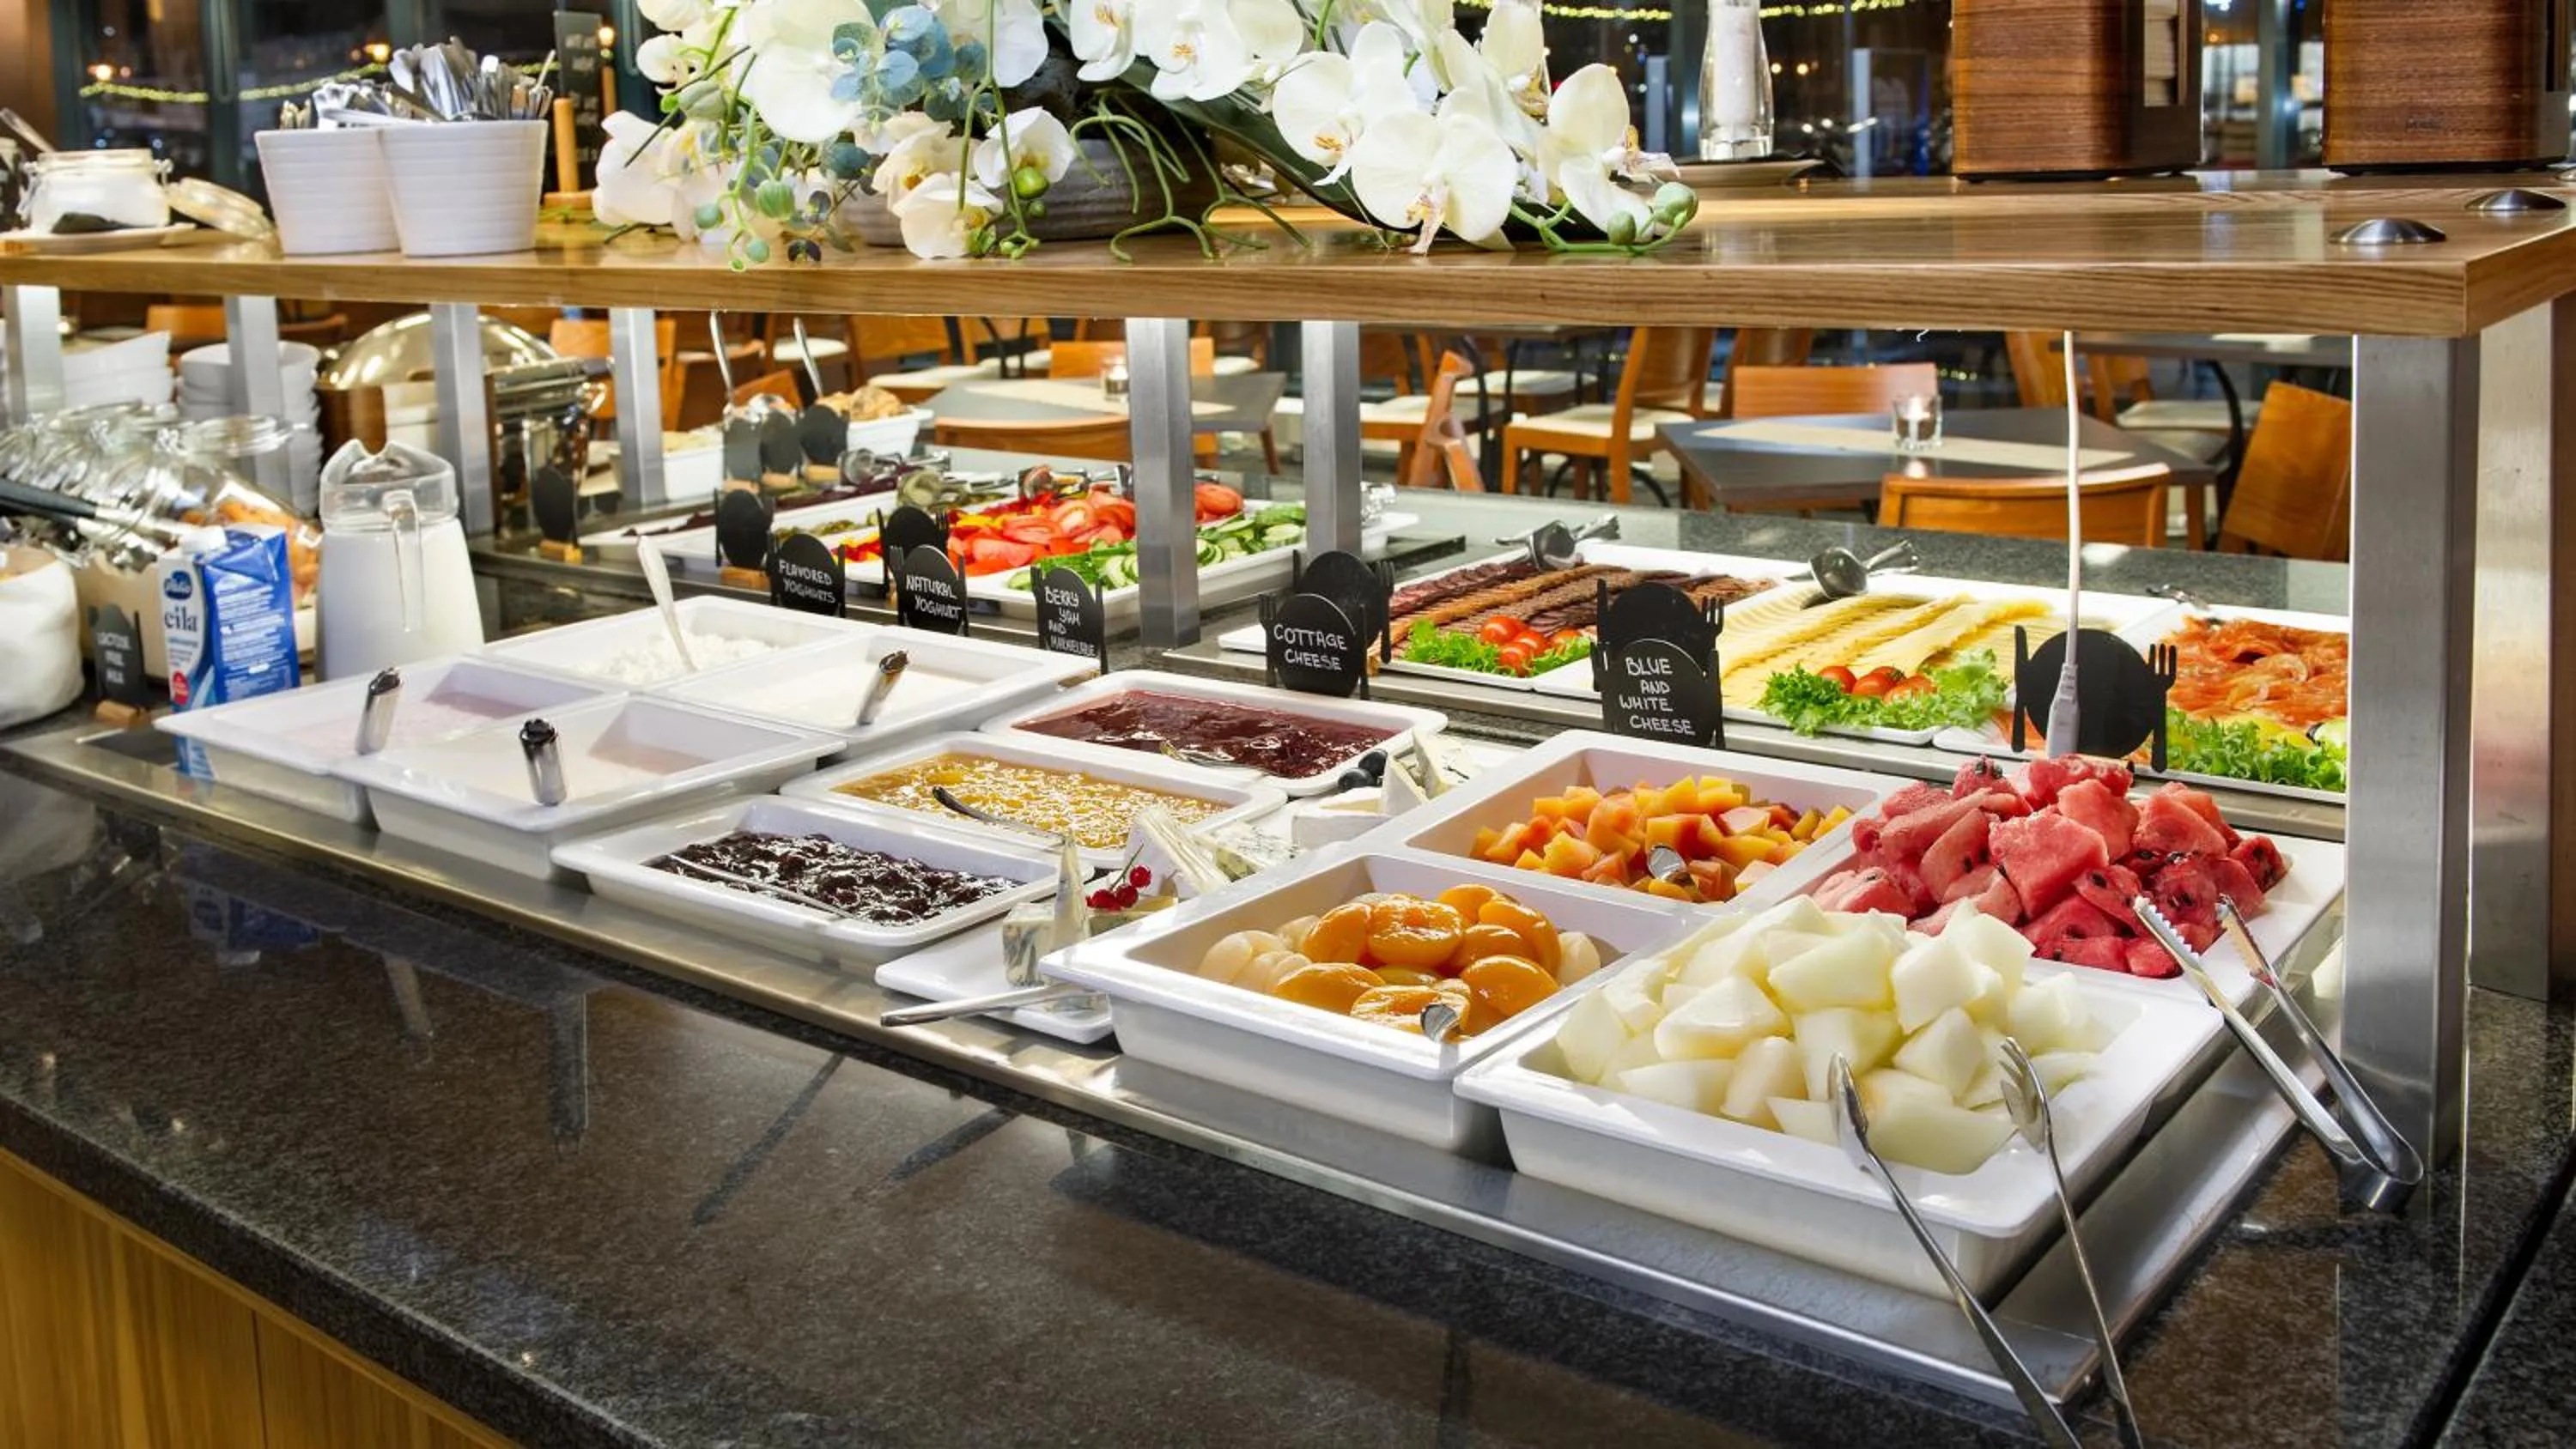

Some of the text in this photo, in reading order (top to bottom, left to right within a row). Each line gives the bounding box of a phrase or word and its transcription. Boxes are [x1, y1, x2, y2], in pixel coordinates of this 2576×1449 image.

[779, 558, 832, 585] FLAVORED
[906, 573, 959, 600] NATURAL
[1044, 585, 1080, 608] BERRY
[914, 594, 963, 621] YOGHURT
[1273, 623, 1347, 651] COTTAGE
[1284, 648, 1342, 671] CHEESE
[1625, 656, 1674, 676] BLUE
[1639, 679, 1671, 694] AND
[1619, 694, 1674, 712] WHITE
[1630, 714, 1697, 736] CHEESE
